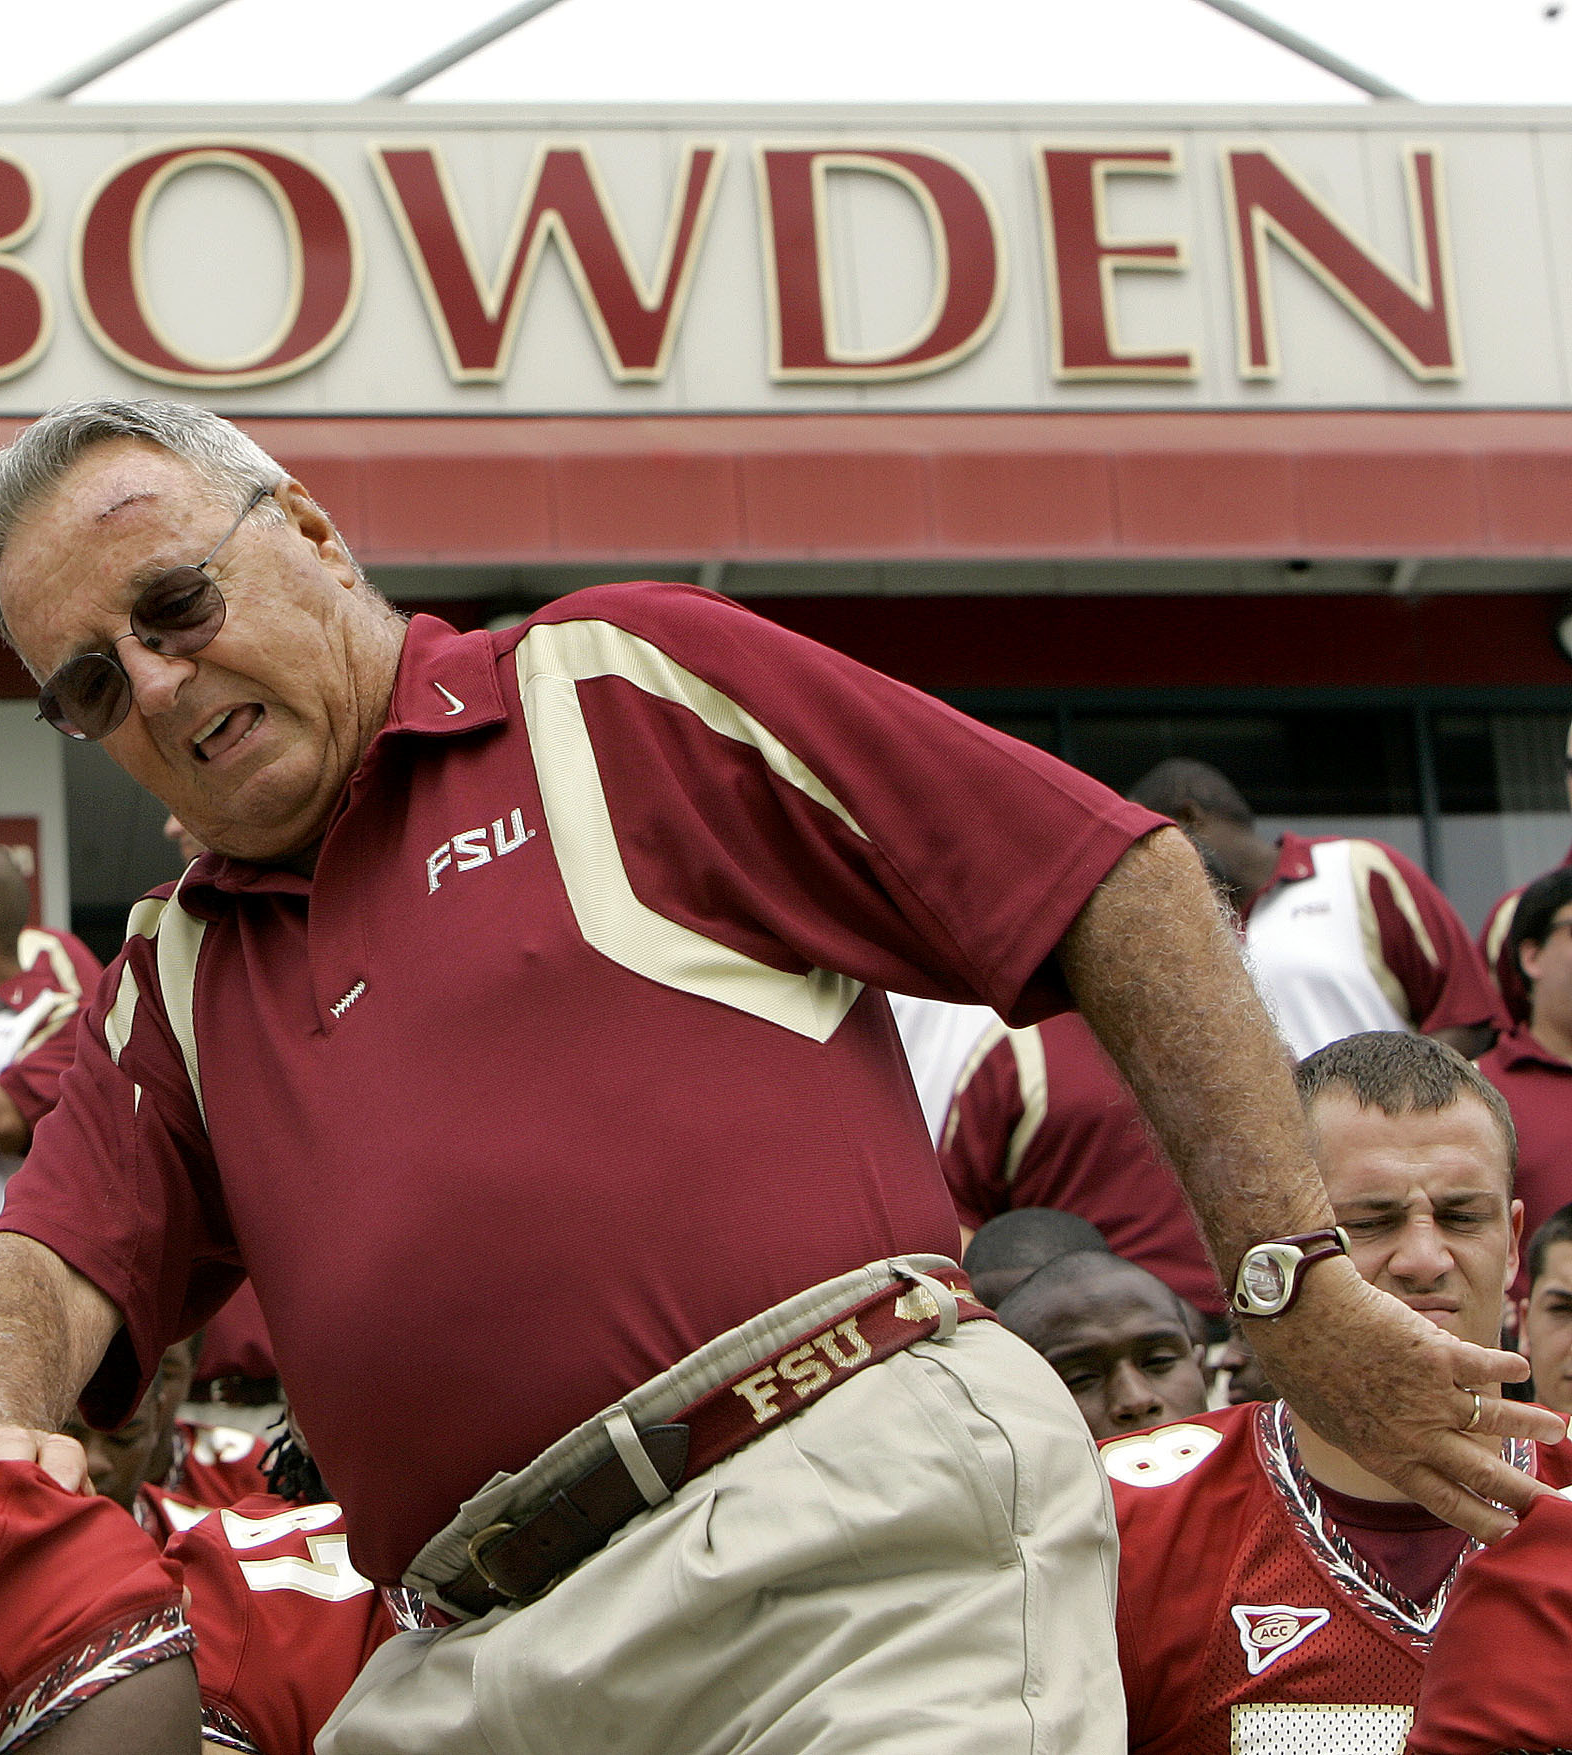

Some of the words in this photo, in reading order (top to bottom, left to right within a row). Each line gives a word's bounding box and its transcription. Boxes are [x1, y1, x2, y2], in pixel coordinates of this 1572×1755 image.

[426, 807, 536, 895] FSU
[732, 1316, 872, 1424] FSU
[1260, 1625, 1288, 1640] ACC
